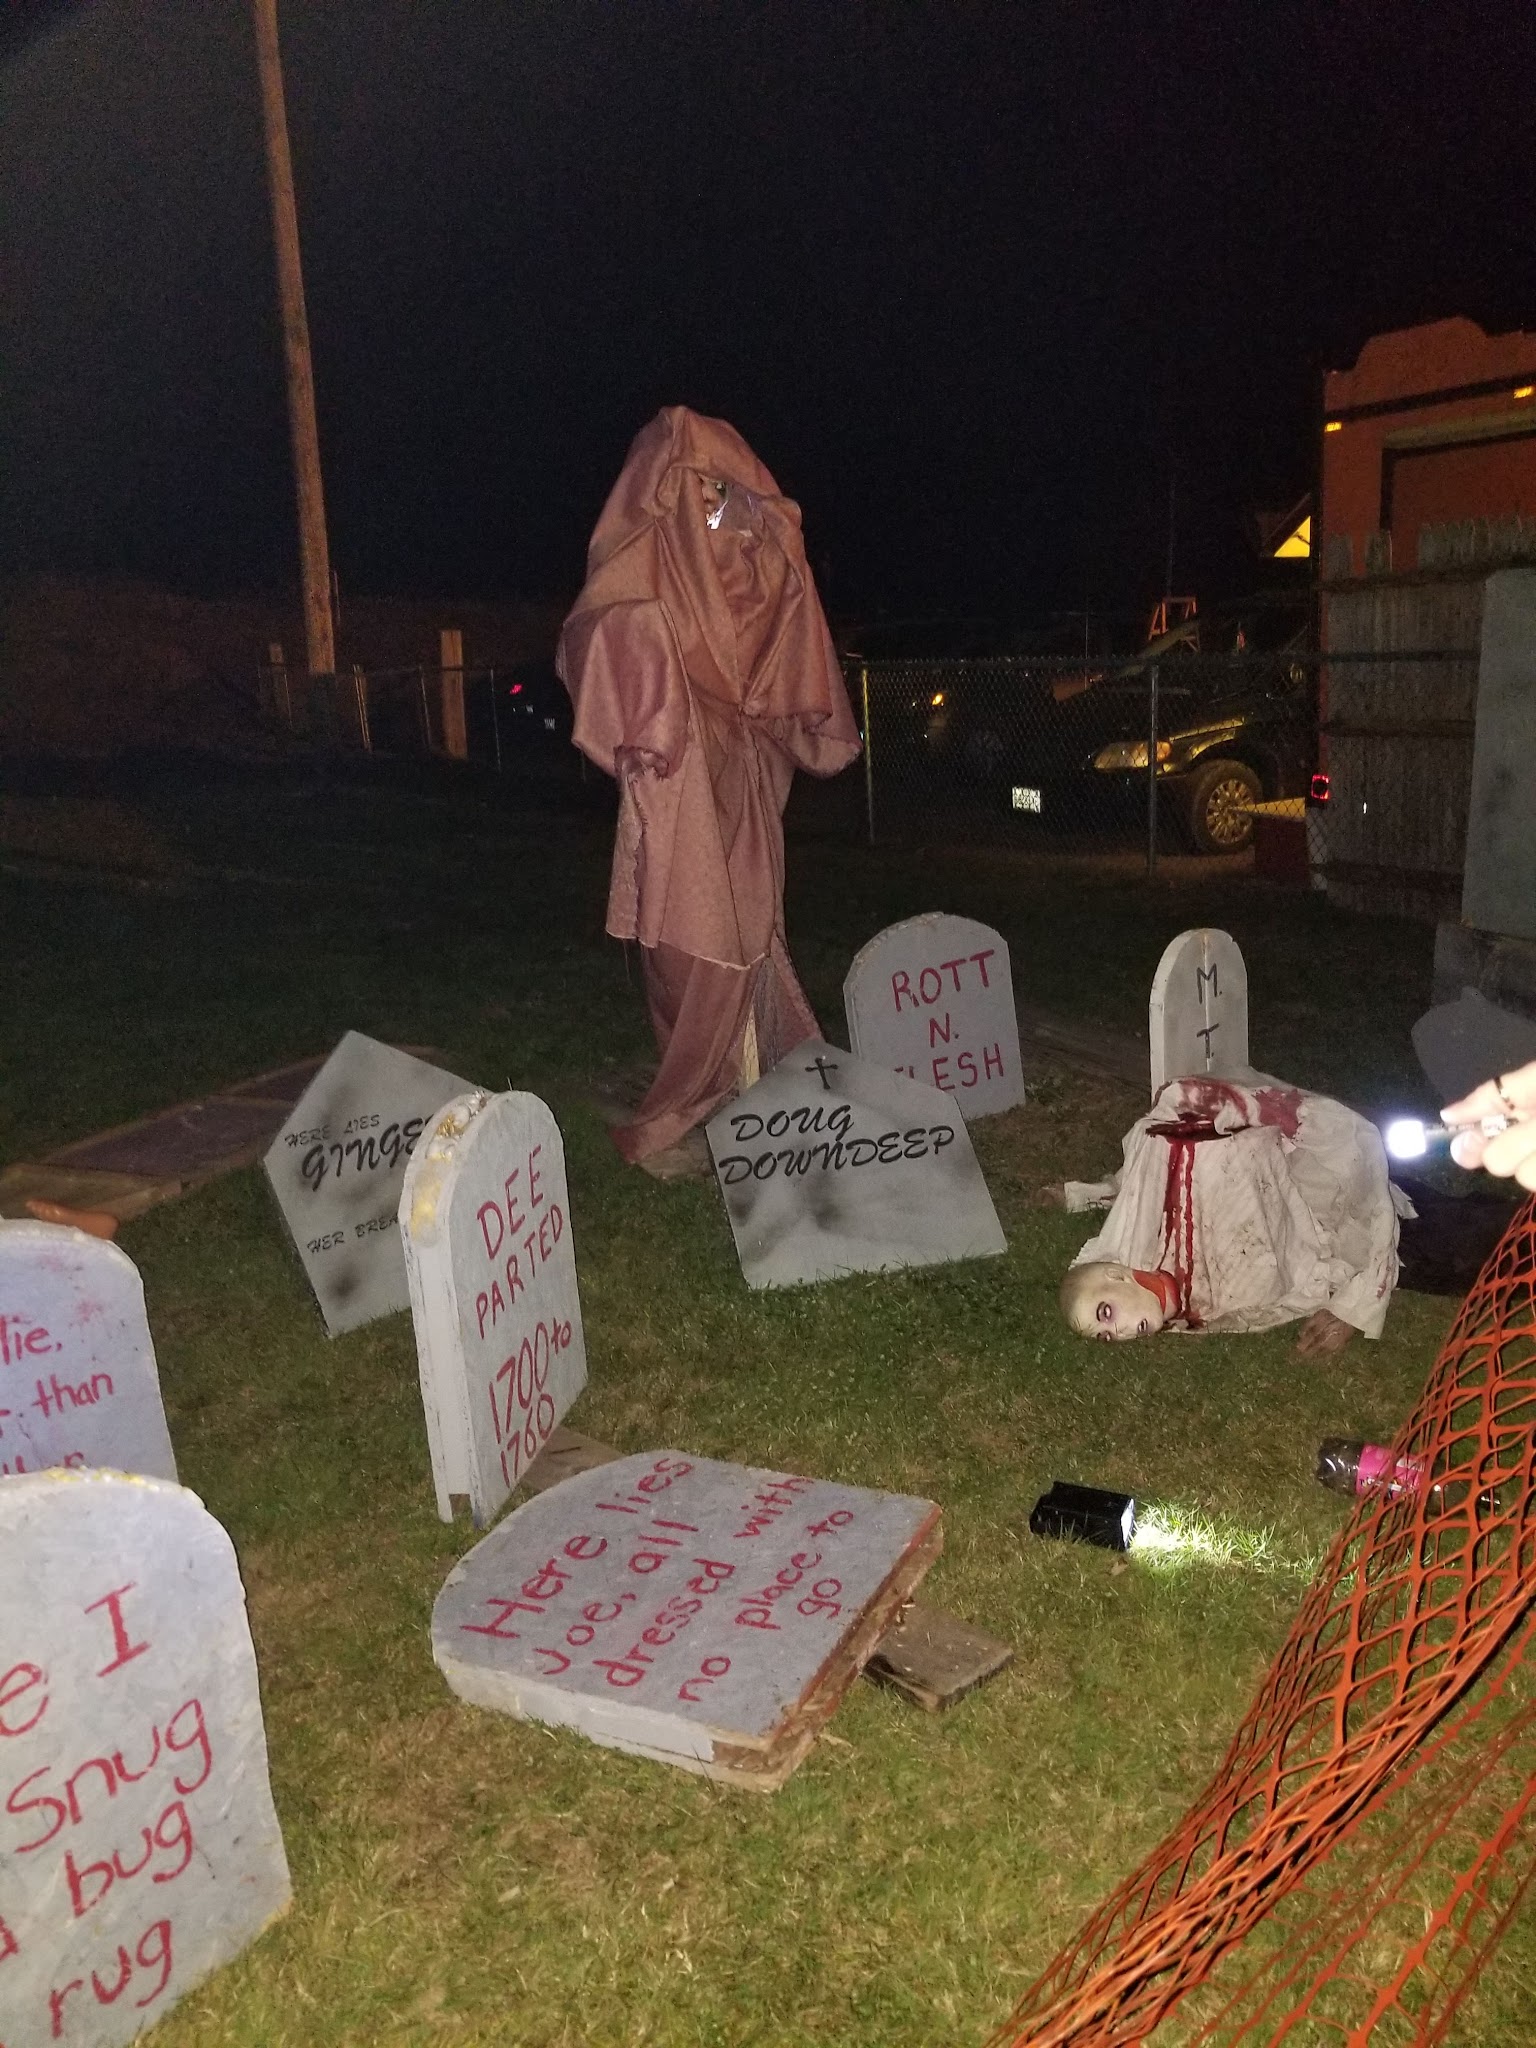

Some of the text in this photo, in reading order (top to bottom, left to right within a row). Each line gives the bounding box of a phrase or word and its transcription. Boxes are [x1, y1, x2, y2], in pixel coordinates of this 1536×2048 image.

[891, 949, 995, 1013] ROTT
[1196, 962, 1223, 1005] M.
[893, 1043, 1004, 1092] ESH
[928, 1012, 960, 1048] N.
[284, 1124, 332, 1148] HERE
[301, 1113, 434, 1192] GINGE
[718, 1125, 955, 1185] DOWNDEEP
[730, 1104, 854, 1142] DOUG
[306, 1230, 345, 1254] HER
[476, 1143, 544, 1261] DEE
[475, 1203, 563, 1341] PARTED
[31, 1373, 114, 1419] than
[489, 1316, 572, 1445] 1700 to
[460, 1457, 694, 1640] Here lies
[592, 1476, 815, 1688] dressed with
[83, 1581, 152, 1679] I
[533, 1519, 699, 1676] Joe, all
[676, 1509, 854, 1702] no place to
[797, 1577, 843, 1619] go
[6, 1698, 213, 1854] Snug
[64, 1799, 194, 1919] bug
[48, 1919, 173, 2040] rug
